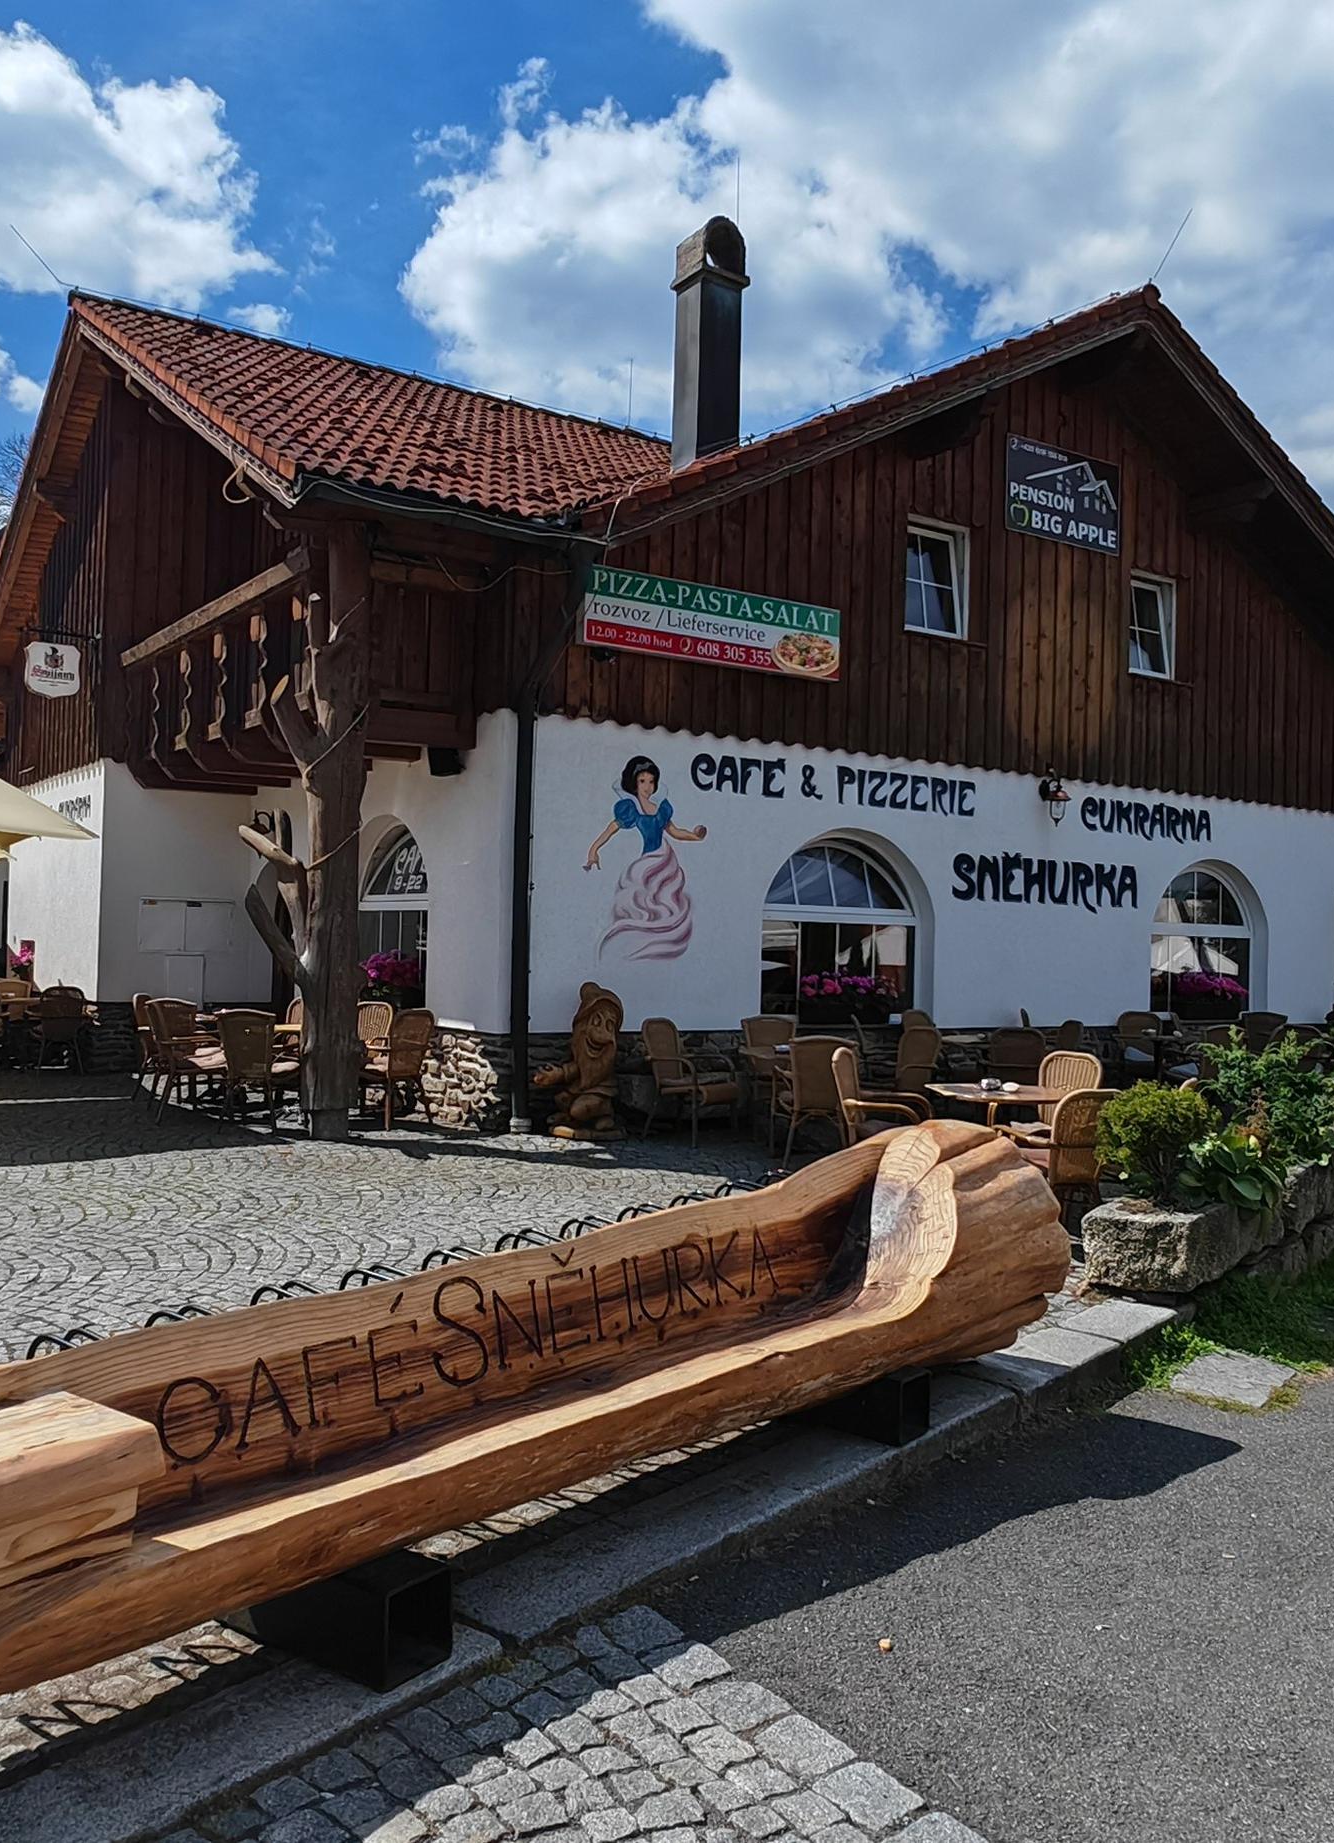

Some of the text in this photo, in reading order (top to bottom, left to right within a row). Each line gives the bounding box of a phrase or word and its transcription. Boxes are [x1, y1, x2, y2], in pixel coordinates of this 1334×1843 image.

[1009, 481, 1075, 513] PENSION
[1031, 510, 1117, 549] BIG APPLE
[592, 568, 835, 633] PIZZA-PASTA-SALAT
[592, 600, 652, 624] rozvoz
[590, 625, 617, 640] 12.00
[625, 630, 652, 645] 22.00
[652, 634, 673, 649] hod
[697, 641, 720, 657] 608
[723, 645, 747, 662] 305
[749, 649, 772, 666] 355
[800, 763, 823, 801] &
[836, 764, 976, 817] PIZZERIE
[951, 851, 1139, 915] SNĚHURKA
[157, 1228, 781, 1465] CAFÉ SNĚHURKA
